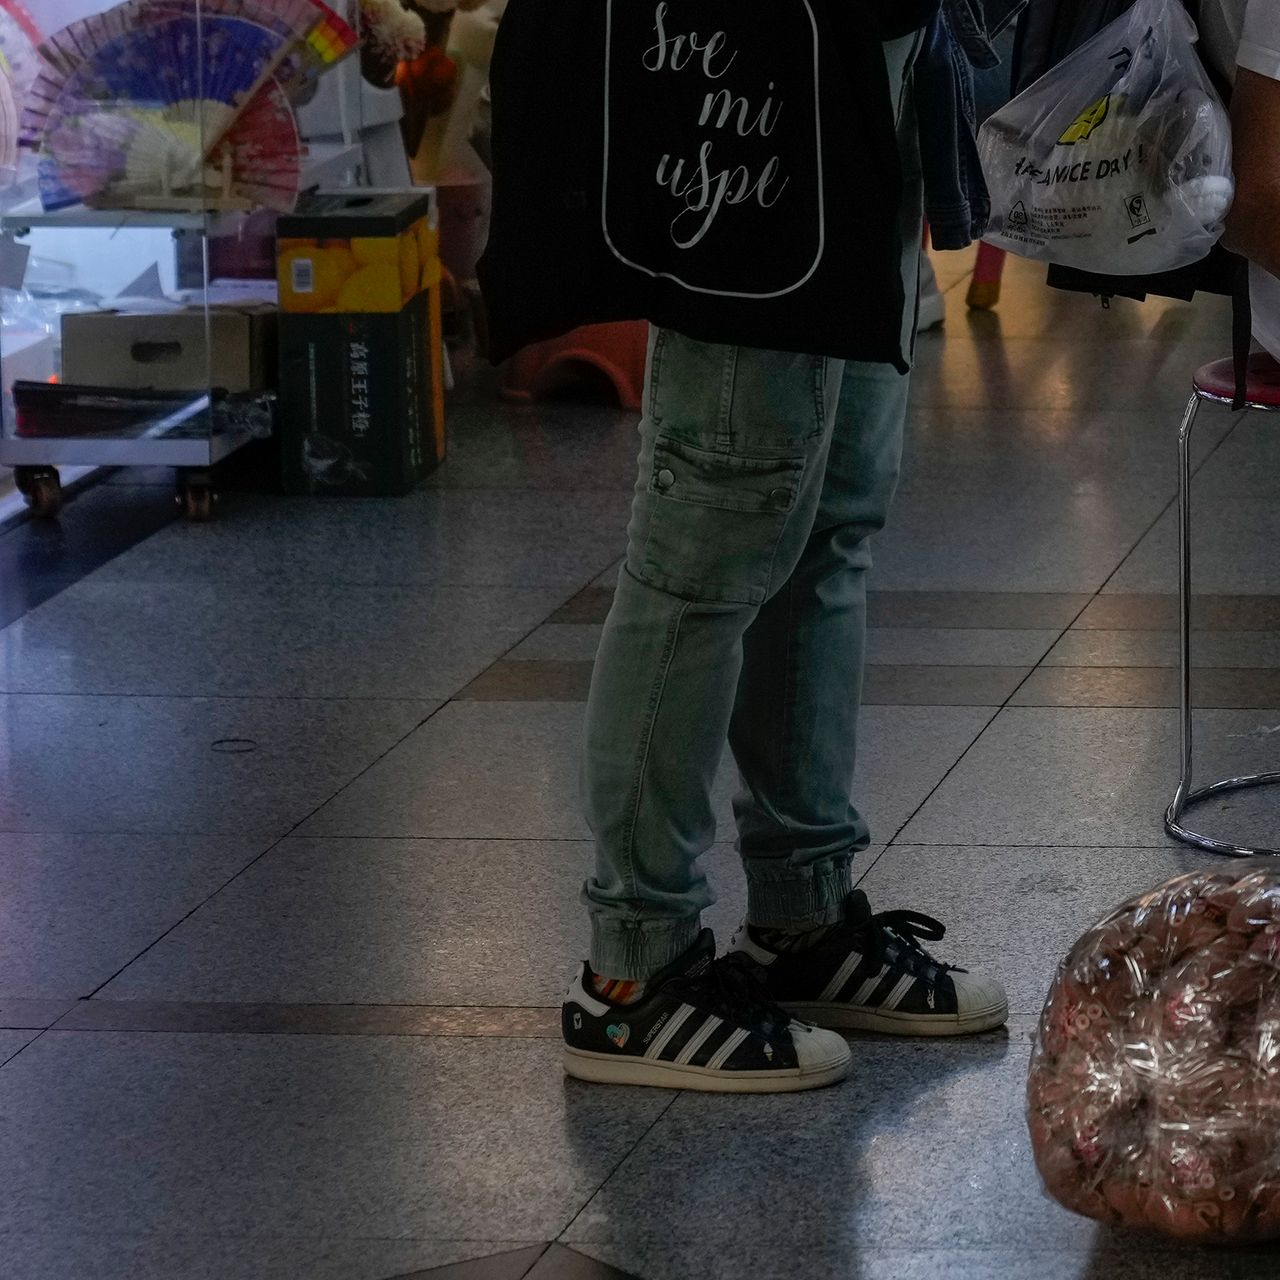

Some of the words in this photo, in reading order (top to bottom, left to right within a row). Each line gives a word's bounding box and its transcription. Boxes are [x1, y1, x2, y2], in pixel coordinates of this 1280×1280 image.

[642, 0, 738, 79] Sve
[697, 81, 784, 137] mi
[655, 140, 789, 249] uspe
[1052, 161, 1092, 184] NICE
[643, 1012, 670, 1044] SUPERSTAR
